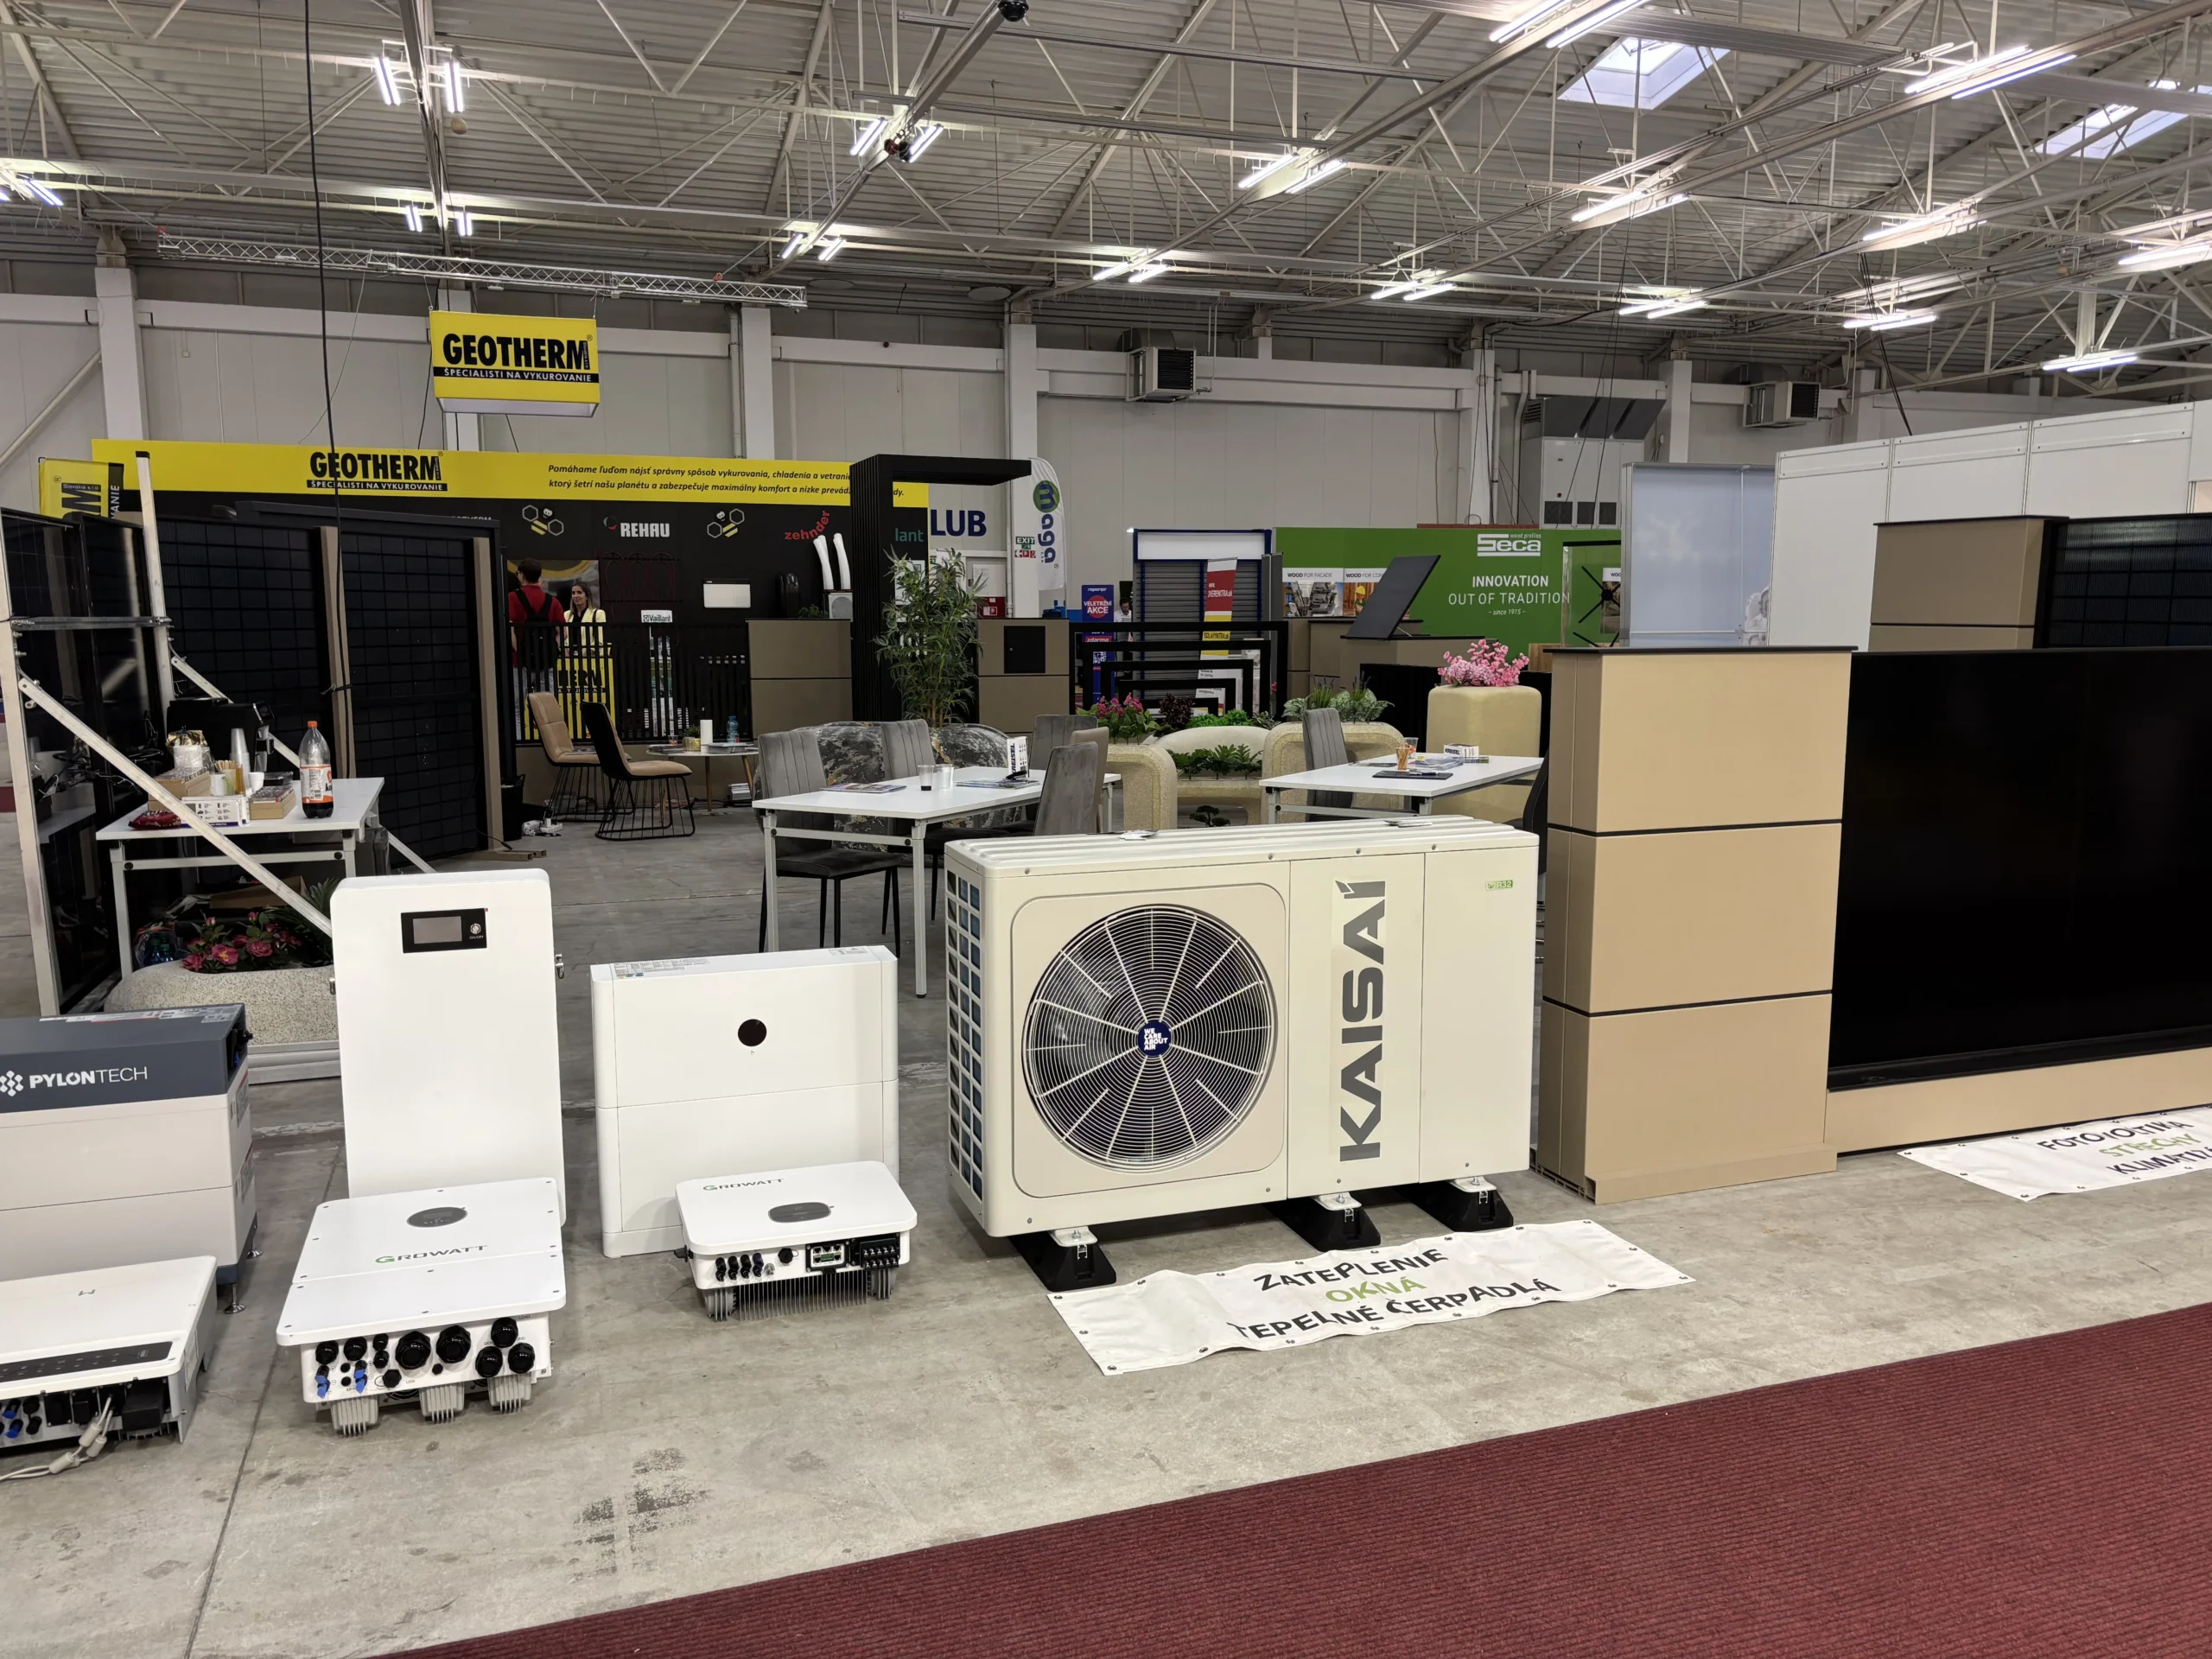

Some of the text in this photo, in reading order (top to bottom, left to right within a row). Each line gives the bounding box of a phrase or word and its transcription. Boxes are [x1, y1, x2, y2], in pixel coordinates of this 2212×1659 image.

[443, 333, 591, 371] GEOTHERM
[444, 367, 592, 383] ŠPECIALISTI NA VYKUROVANIE
[309, 451, 442, 481] GEOTHERM
[548, 464, 597, 474] Pomáhame
[599, 465, 628, 474] ľuďom
[629, 466, 652, 477] nájsť
[652, 467, 686, 478] správny
[687, 467, 716, 478] spôsob
[718, 469, 771, 480] vykurovania,
[772, 470, 811, 480] chladenia
[311, 480, 364, 490] ŠPECIALISTI
[549, 479, 572, 490] ktorý
[573, 480, 594, 489] šetrí
[594, 480, 615, 489] našu
[617, 480, 650, 491] planétu
[659, 481, 709, 493] zabezpečuje
[711, 483, 757, 494] maximálny
[758, 484, 791, 495] komfort
[799, 485, 820, 494] nízke
[620, 522, 671, 538] REHAU
[784, 510, 830, 540] zehnder
[1036, 481, 1058, 564] maga
[1477, 533, 1541, 552] Seca
[1472, 575, 1549, 588] INNOVATION
[1448, 591, 1570, 606] OUT OF TRADITION
[1087, 606, 1109, 614] AKCE
[1496, 880, 1513, 888] R32
[1334, 880, 1386, 1162] KAISAI
[1143, 1037, 1168, 1046] ABOUT
[29, 1065, 148, 1090] PYLONTECH
[702, 1178, 784, 1192] GROWATT
[375, 1244, 488, 1263] GROWATT
[1253, 1248, 1449, 1292] ZATEPLENIE
[1325, 1275, 1427, 1303] OKNÁ
[1385, 1278, 1562, 1314] ČERPADLÁ
